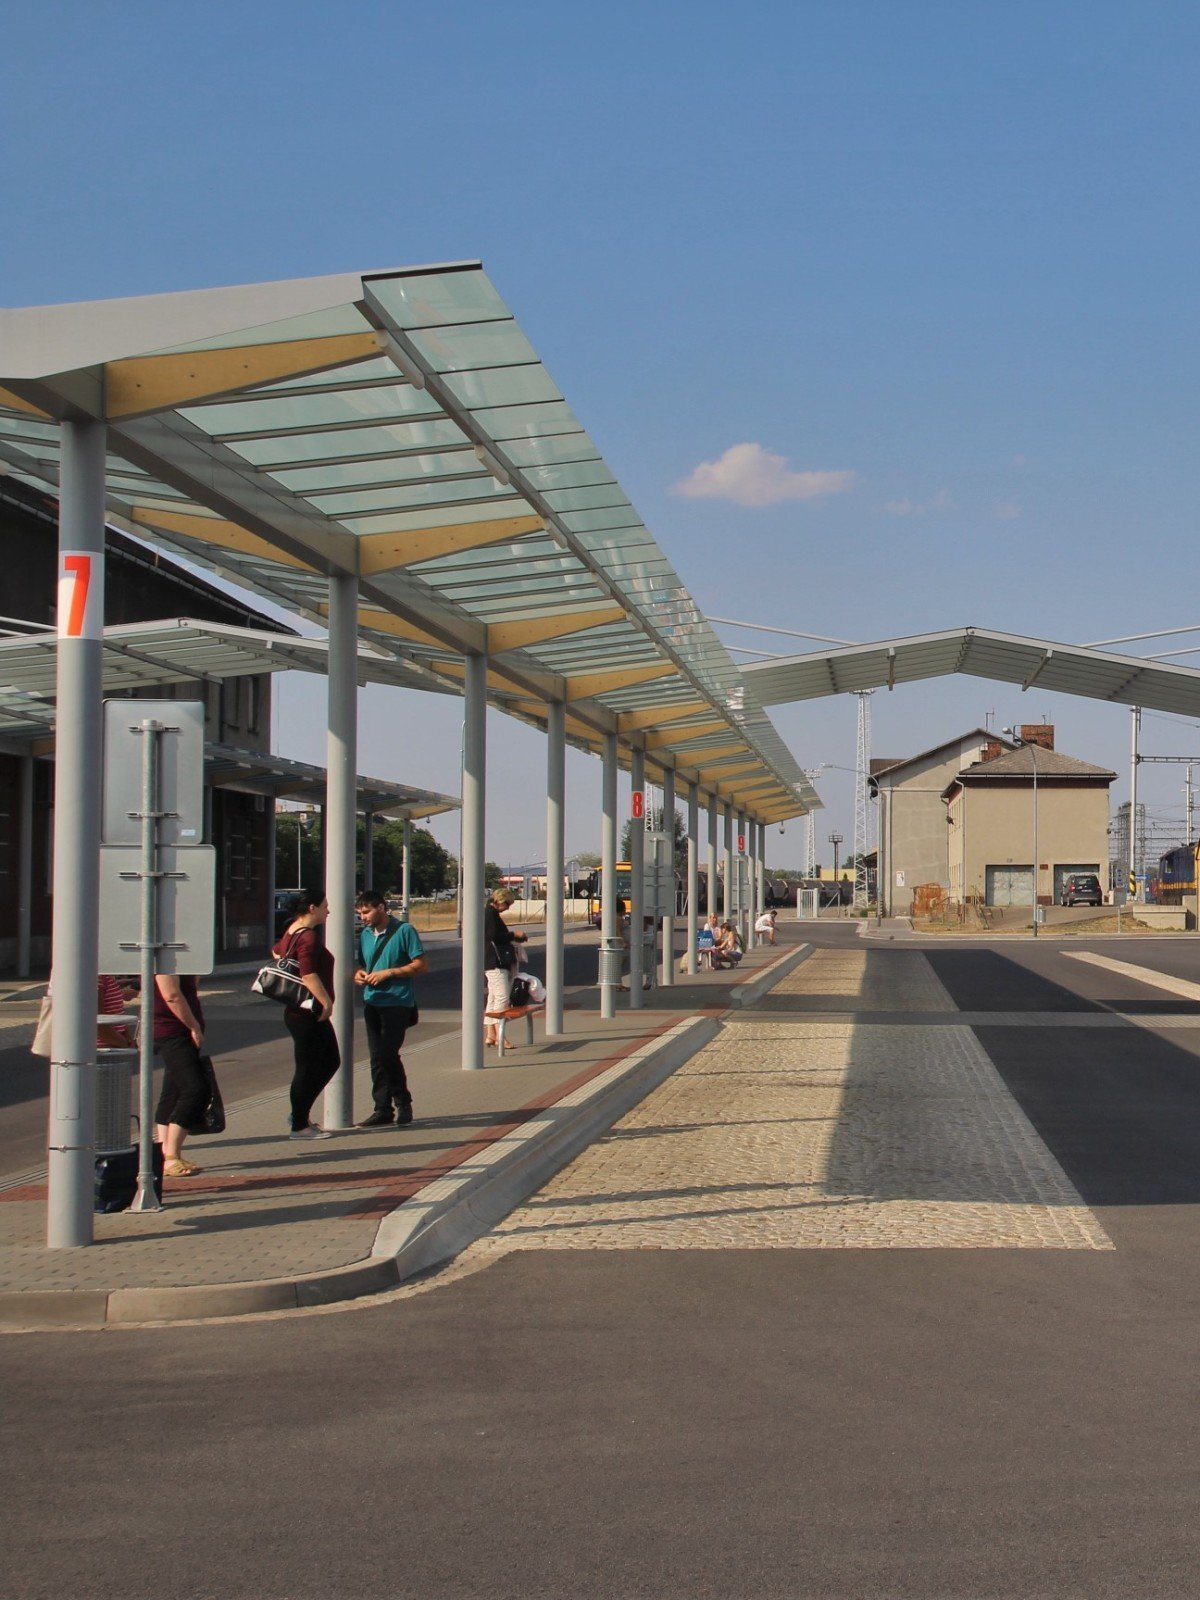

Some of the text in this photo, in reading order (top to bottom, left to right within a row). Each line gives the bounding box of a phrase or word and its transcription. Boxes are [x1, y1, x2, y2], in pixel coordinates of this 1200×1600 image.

[64, 555, 91, 636] 7
[632, 792, 643, 818] 8
[738, 835, 745, 852] 9
